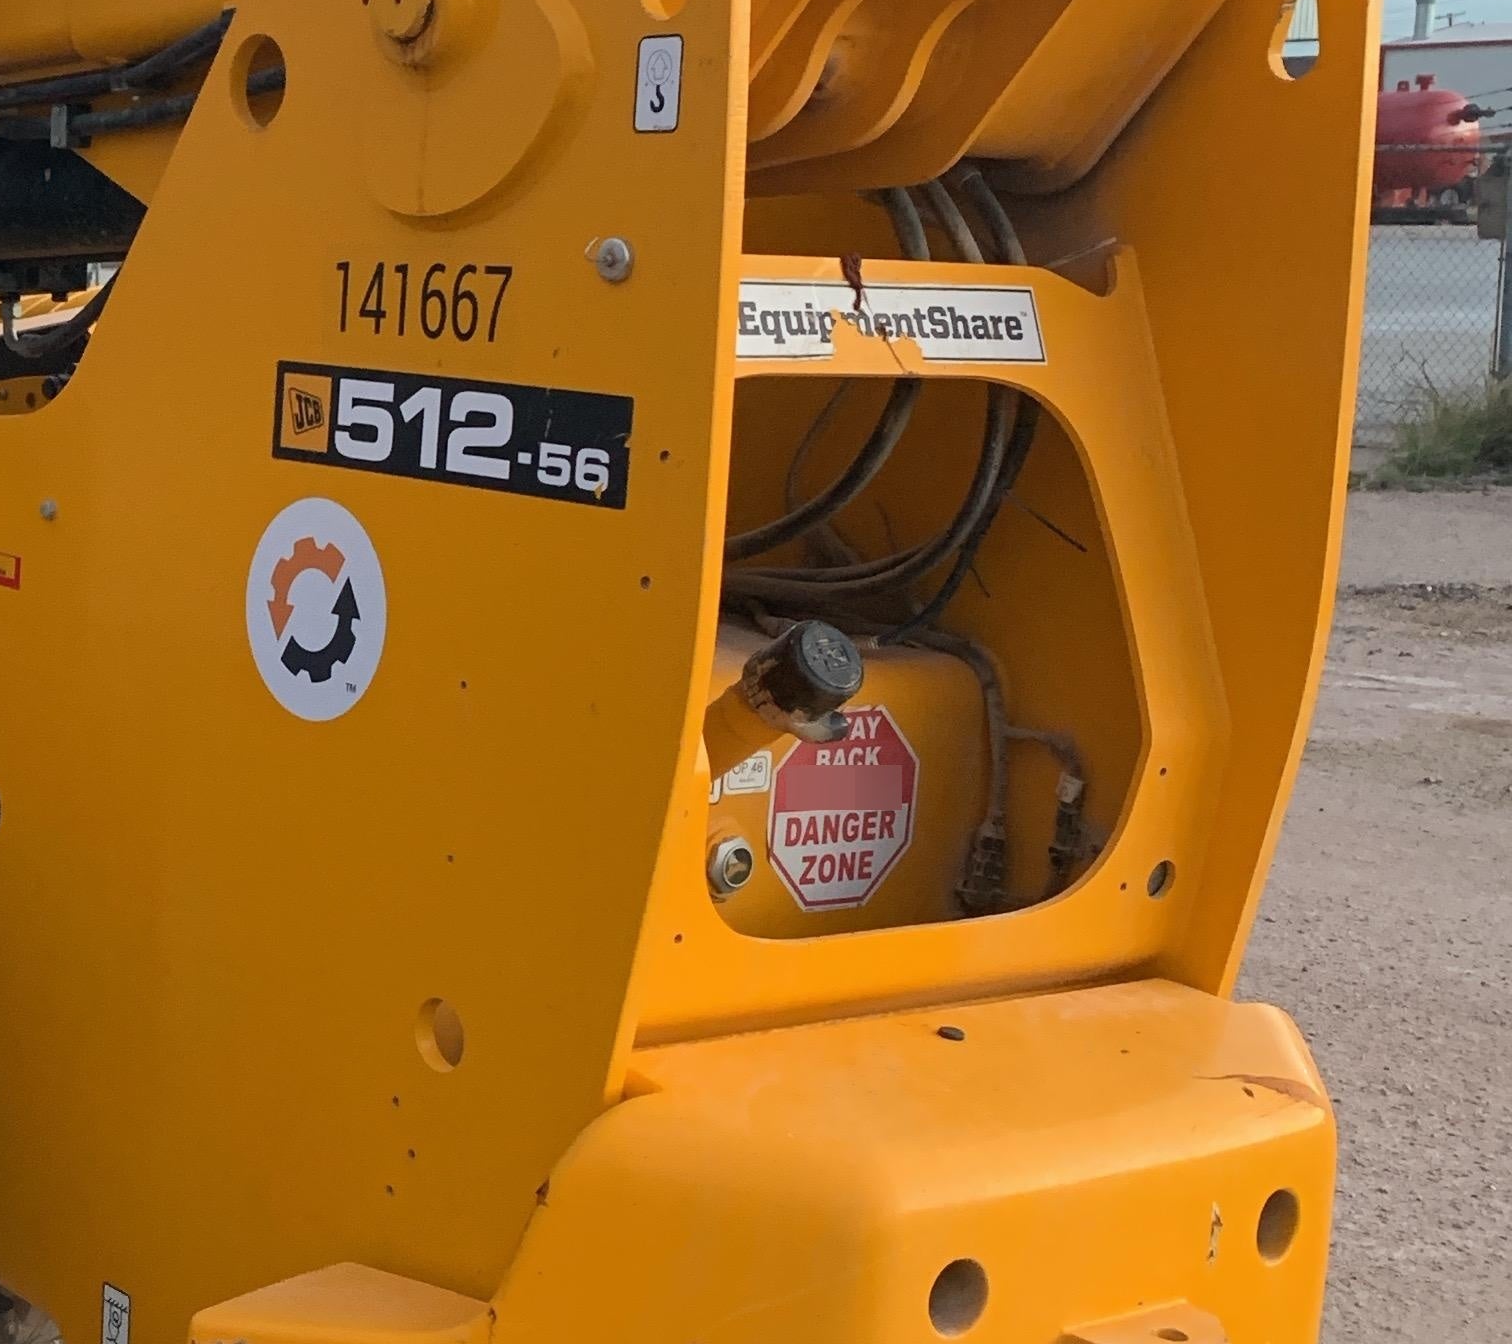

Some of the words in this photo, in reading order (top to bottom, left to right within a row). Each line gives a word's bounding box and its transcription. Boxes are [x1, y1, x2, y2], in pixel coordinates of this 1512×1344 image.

[336, 261, 513, 342] 141667
[294, 392, 323, 431] JCB
[784, 811, 896, 847] DANGER
[799, 850, 874, 886] ZONE
